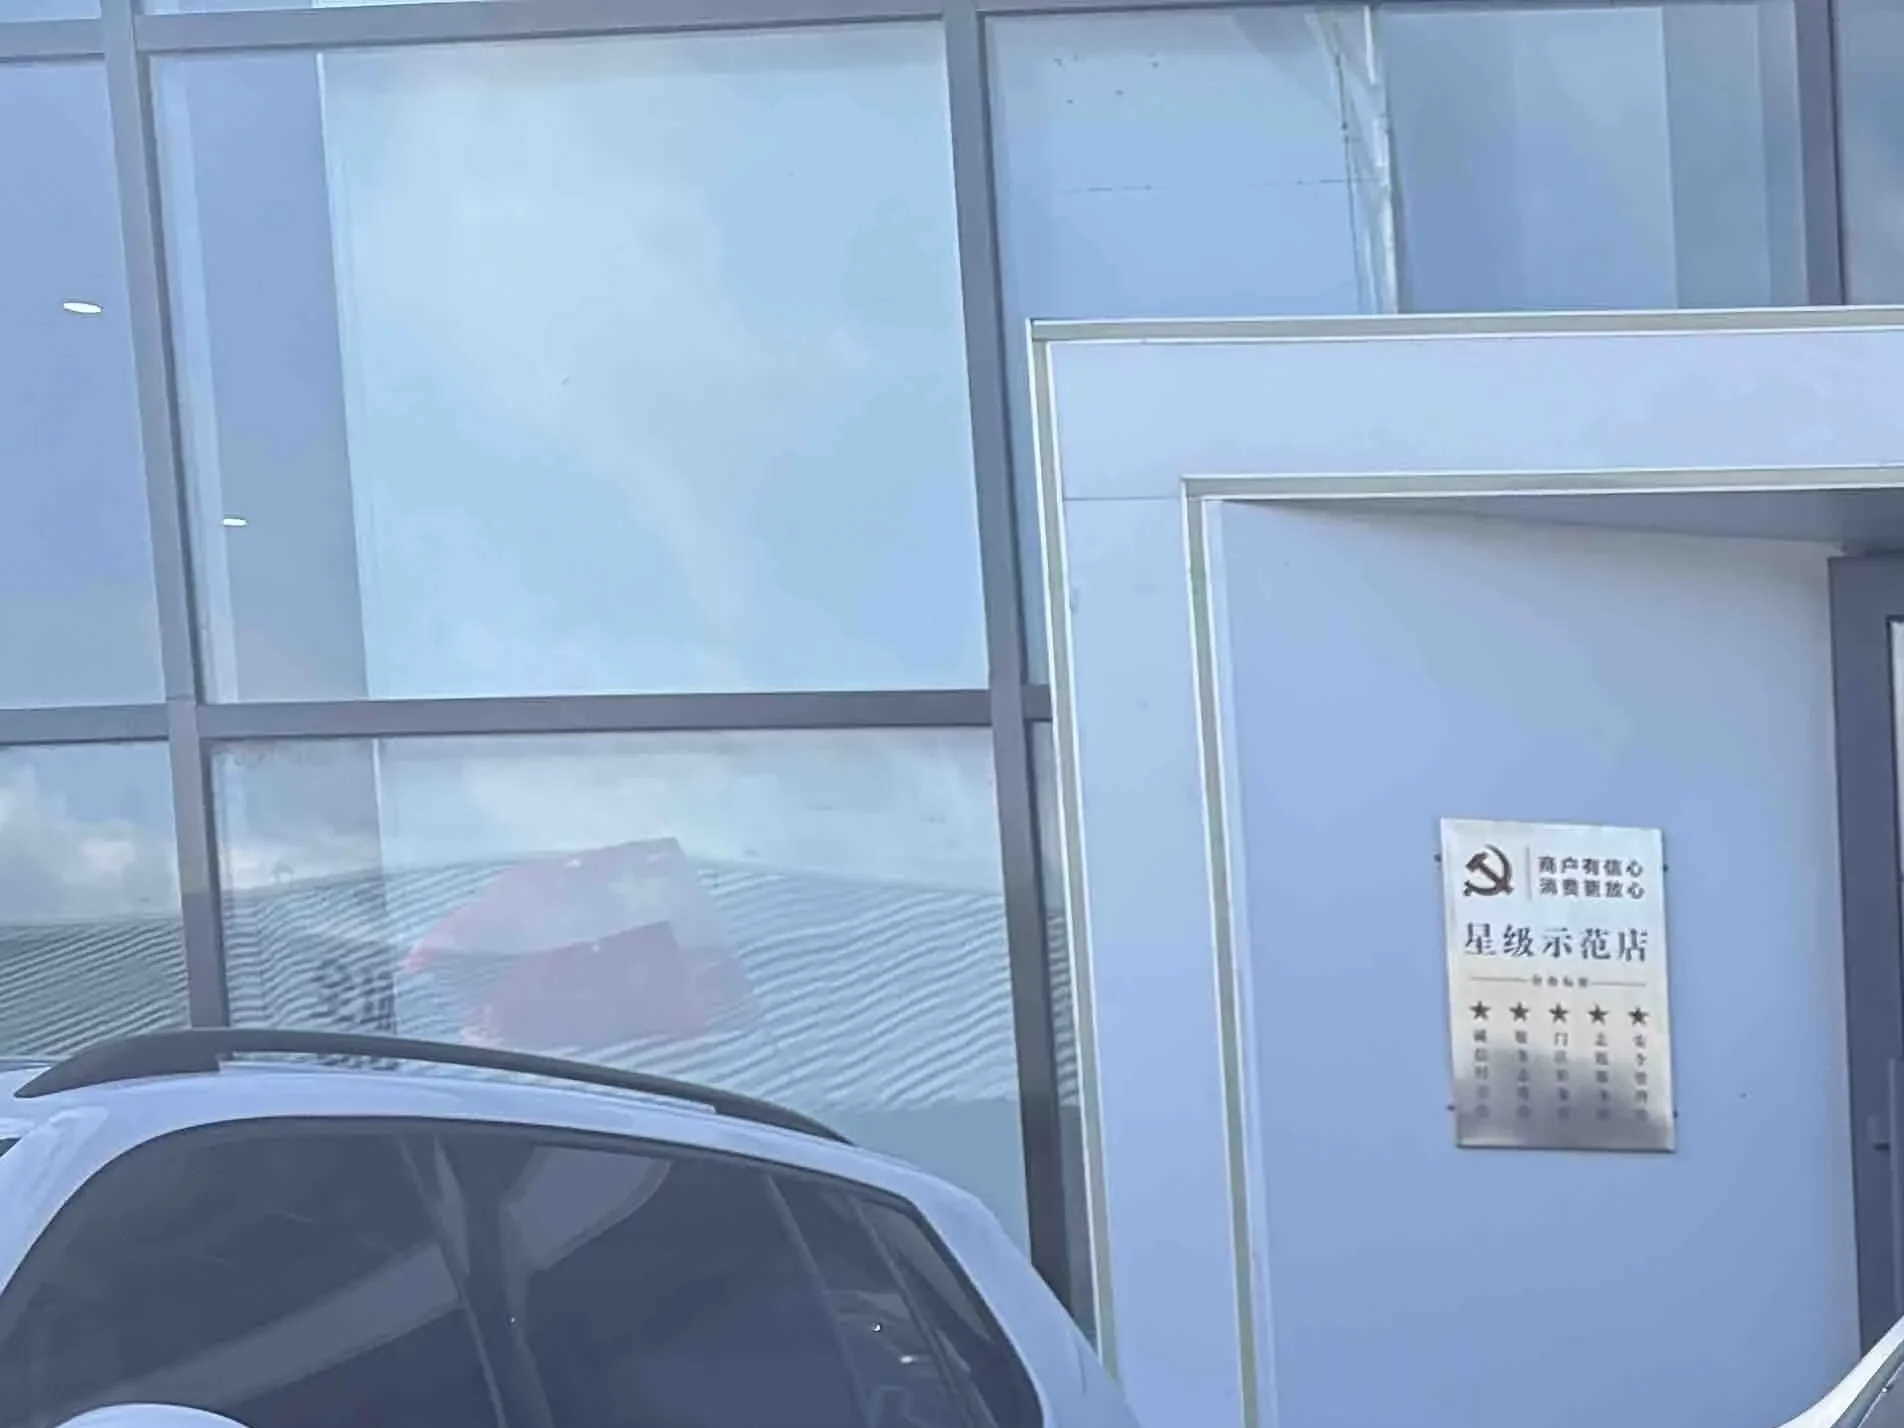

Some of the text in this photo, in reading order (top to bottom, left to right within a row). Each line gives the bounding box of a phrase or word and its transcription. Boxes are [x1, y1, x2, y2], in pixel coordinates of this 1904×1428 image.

[1465, 921, 1649, 962] 星级示范店
